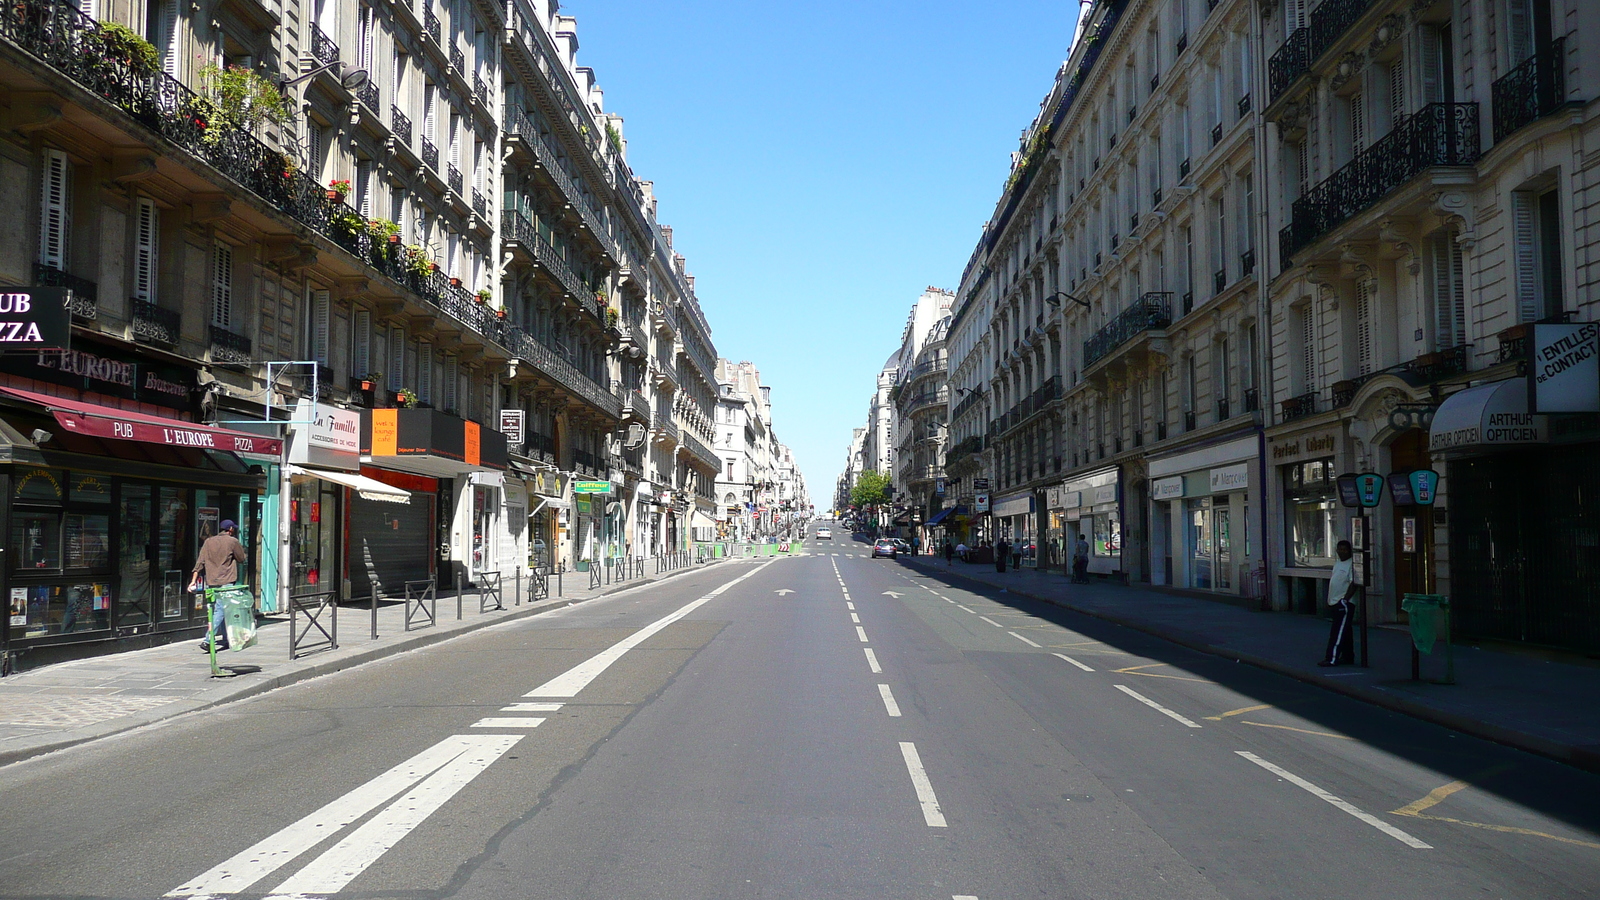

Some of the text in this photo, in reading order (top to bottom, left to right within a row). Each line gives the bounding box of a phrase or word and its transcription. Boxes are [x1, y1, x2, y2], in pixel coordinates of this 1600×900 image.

[0, 293, 31, 313] UB
[1536, 341, 1597, 384] DE CONTACT
[327, 415, 356, 434] Famille
[1489, 414, 1533, 426] ARTHUR
[113, 422, 134, 438] PUB
[163, 428, 215, 447] L'EUROPE
[234, 437, 254, 452] PIZZA
[311, 434, 339, 444] ACCESSOIRES
[1431, 428, 1480, 449] ARTHUR OPTICIEN
[1486, 428, 1538, 441] OPTICIEN
[1221, 472, 1247, 487] Manpower
